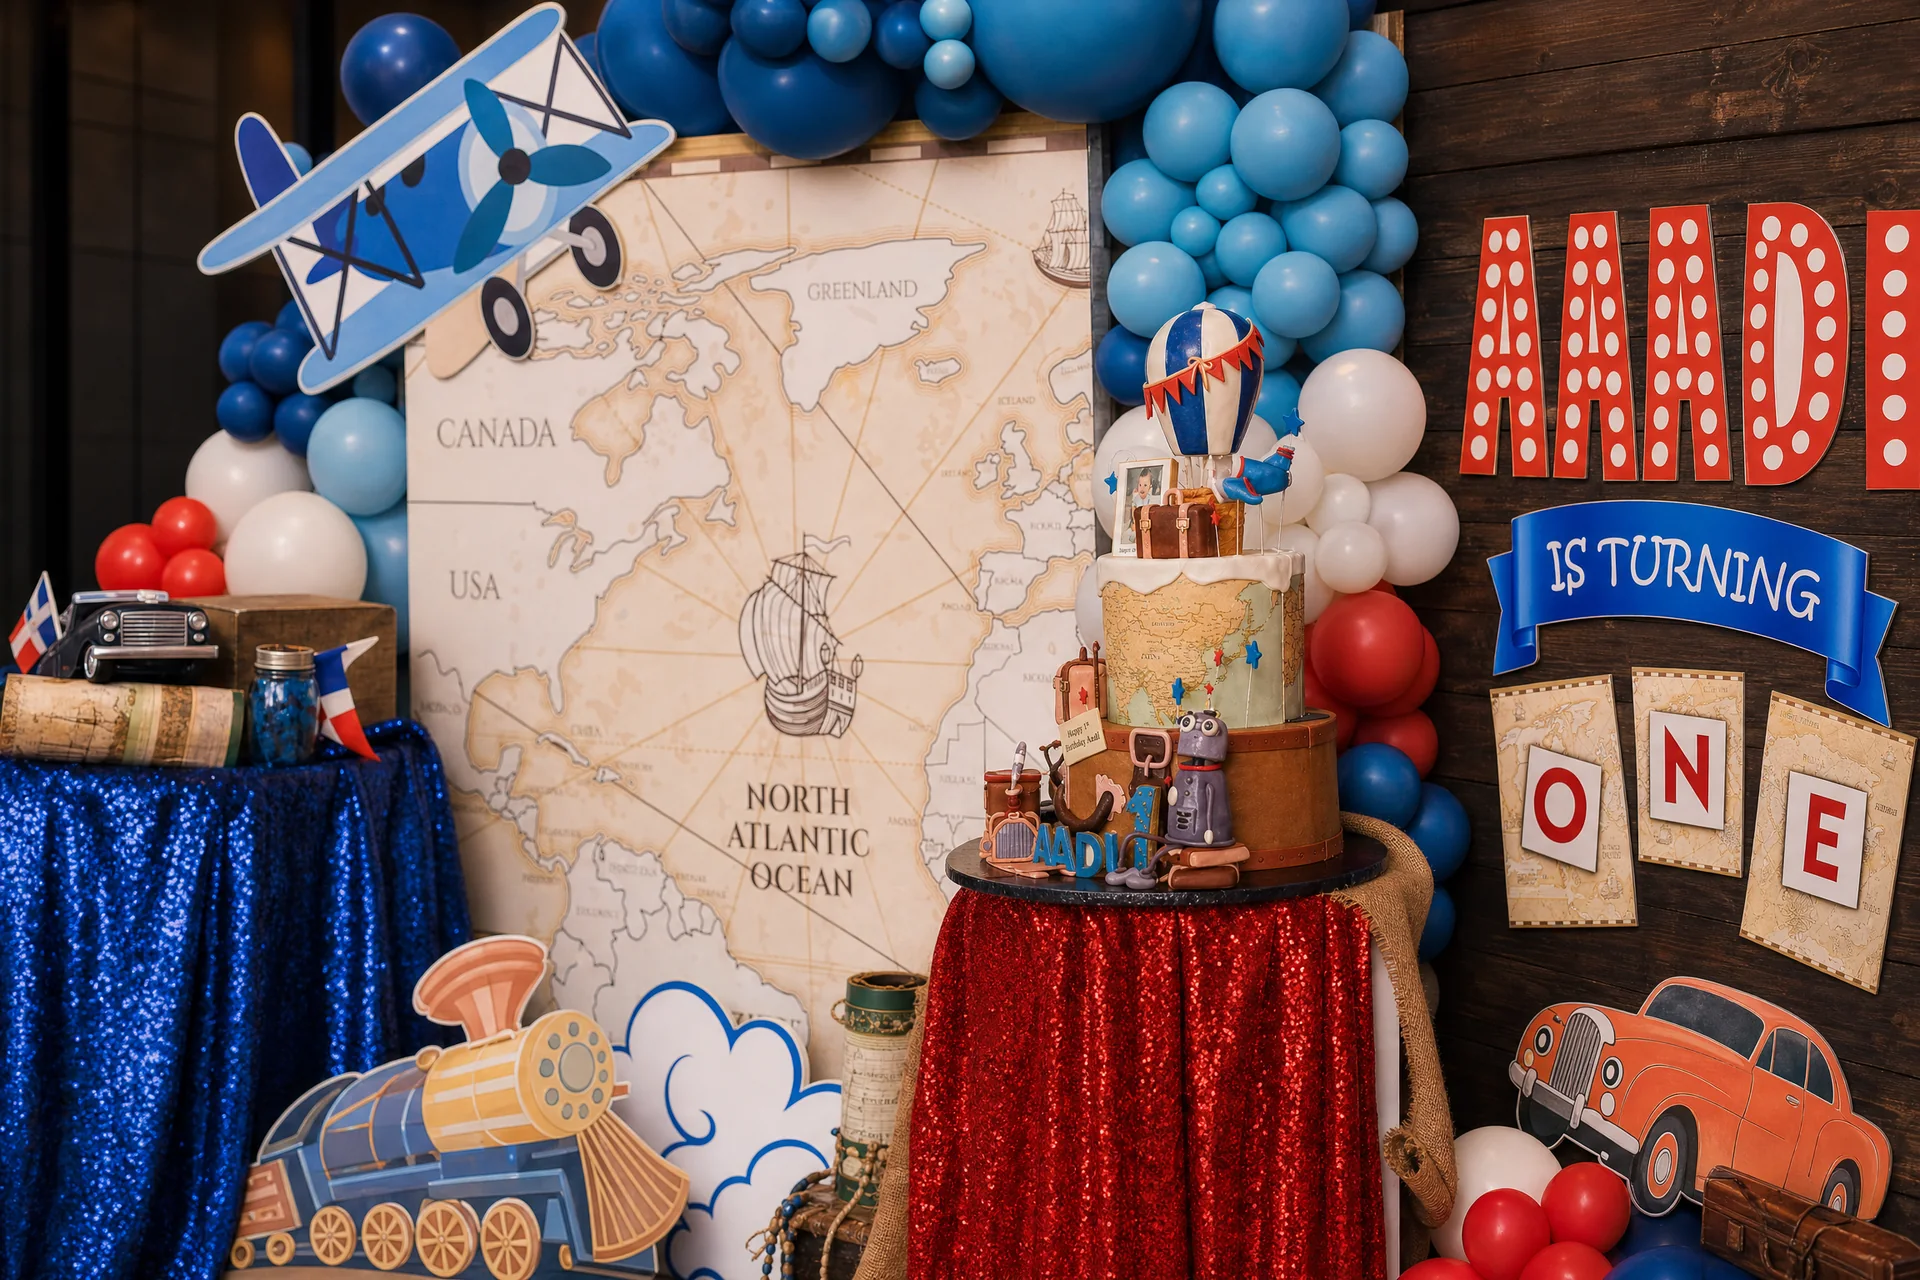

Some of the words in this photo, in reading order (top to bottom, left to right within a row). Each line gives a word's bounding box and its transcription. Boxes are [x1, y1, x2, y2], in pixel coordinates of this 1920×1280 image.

[807, 279, 918, 301] GREENLAND
[1459, 202, 1920, 490] AAADI
[998, 396, 1035, 406] ICELAND
[436, 417, 557, 449] CANADA
[449, 570, 500, 600] USA
[1546, 536, 1586, 596] IS
[1597, 534, 1820, 622] TURNING
[747, 781, 850, 816] NORTH
[727, 821, 871, 858] ATLANTIC
[1032, 822, 1119, 878] AADI
[751, 861, 853, 898] OCEAN
